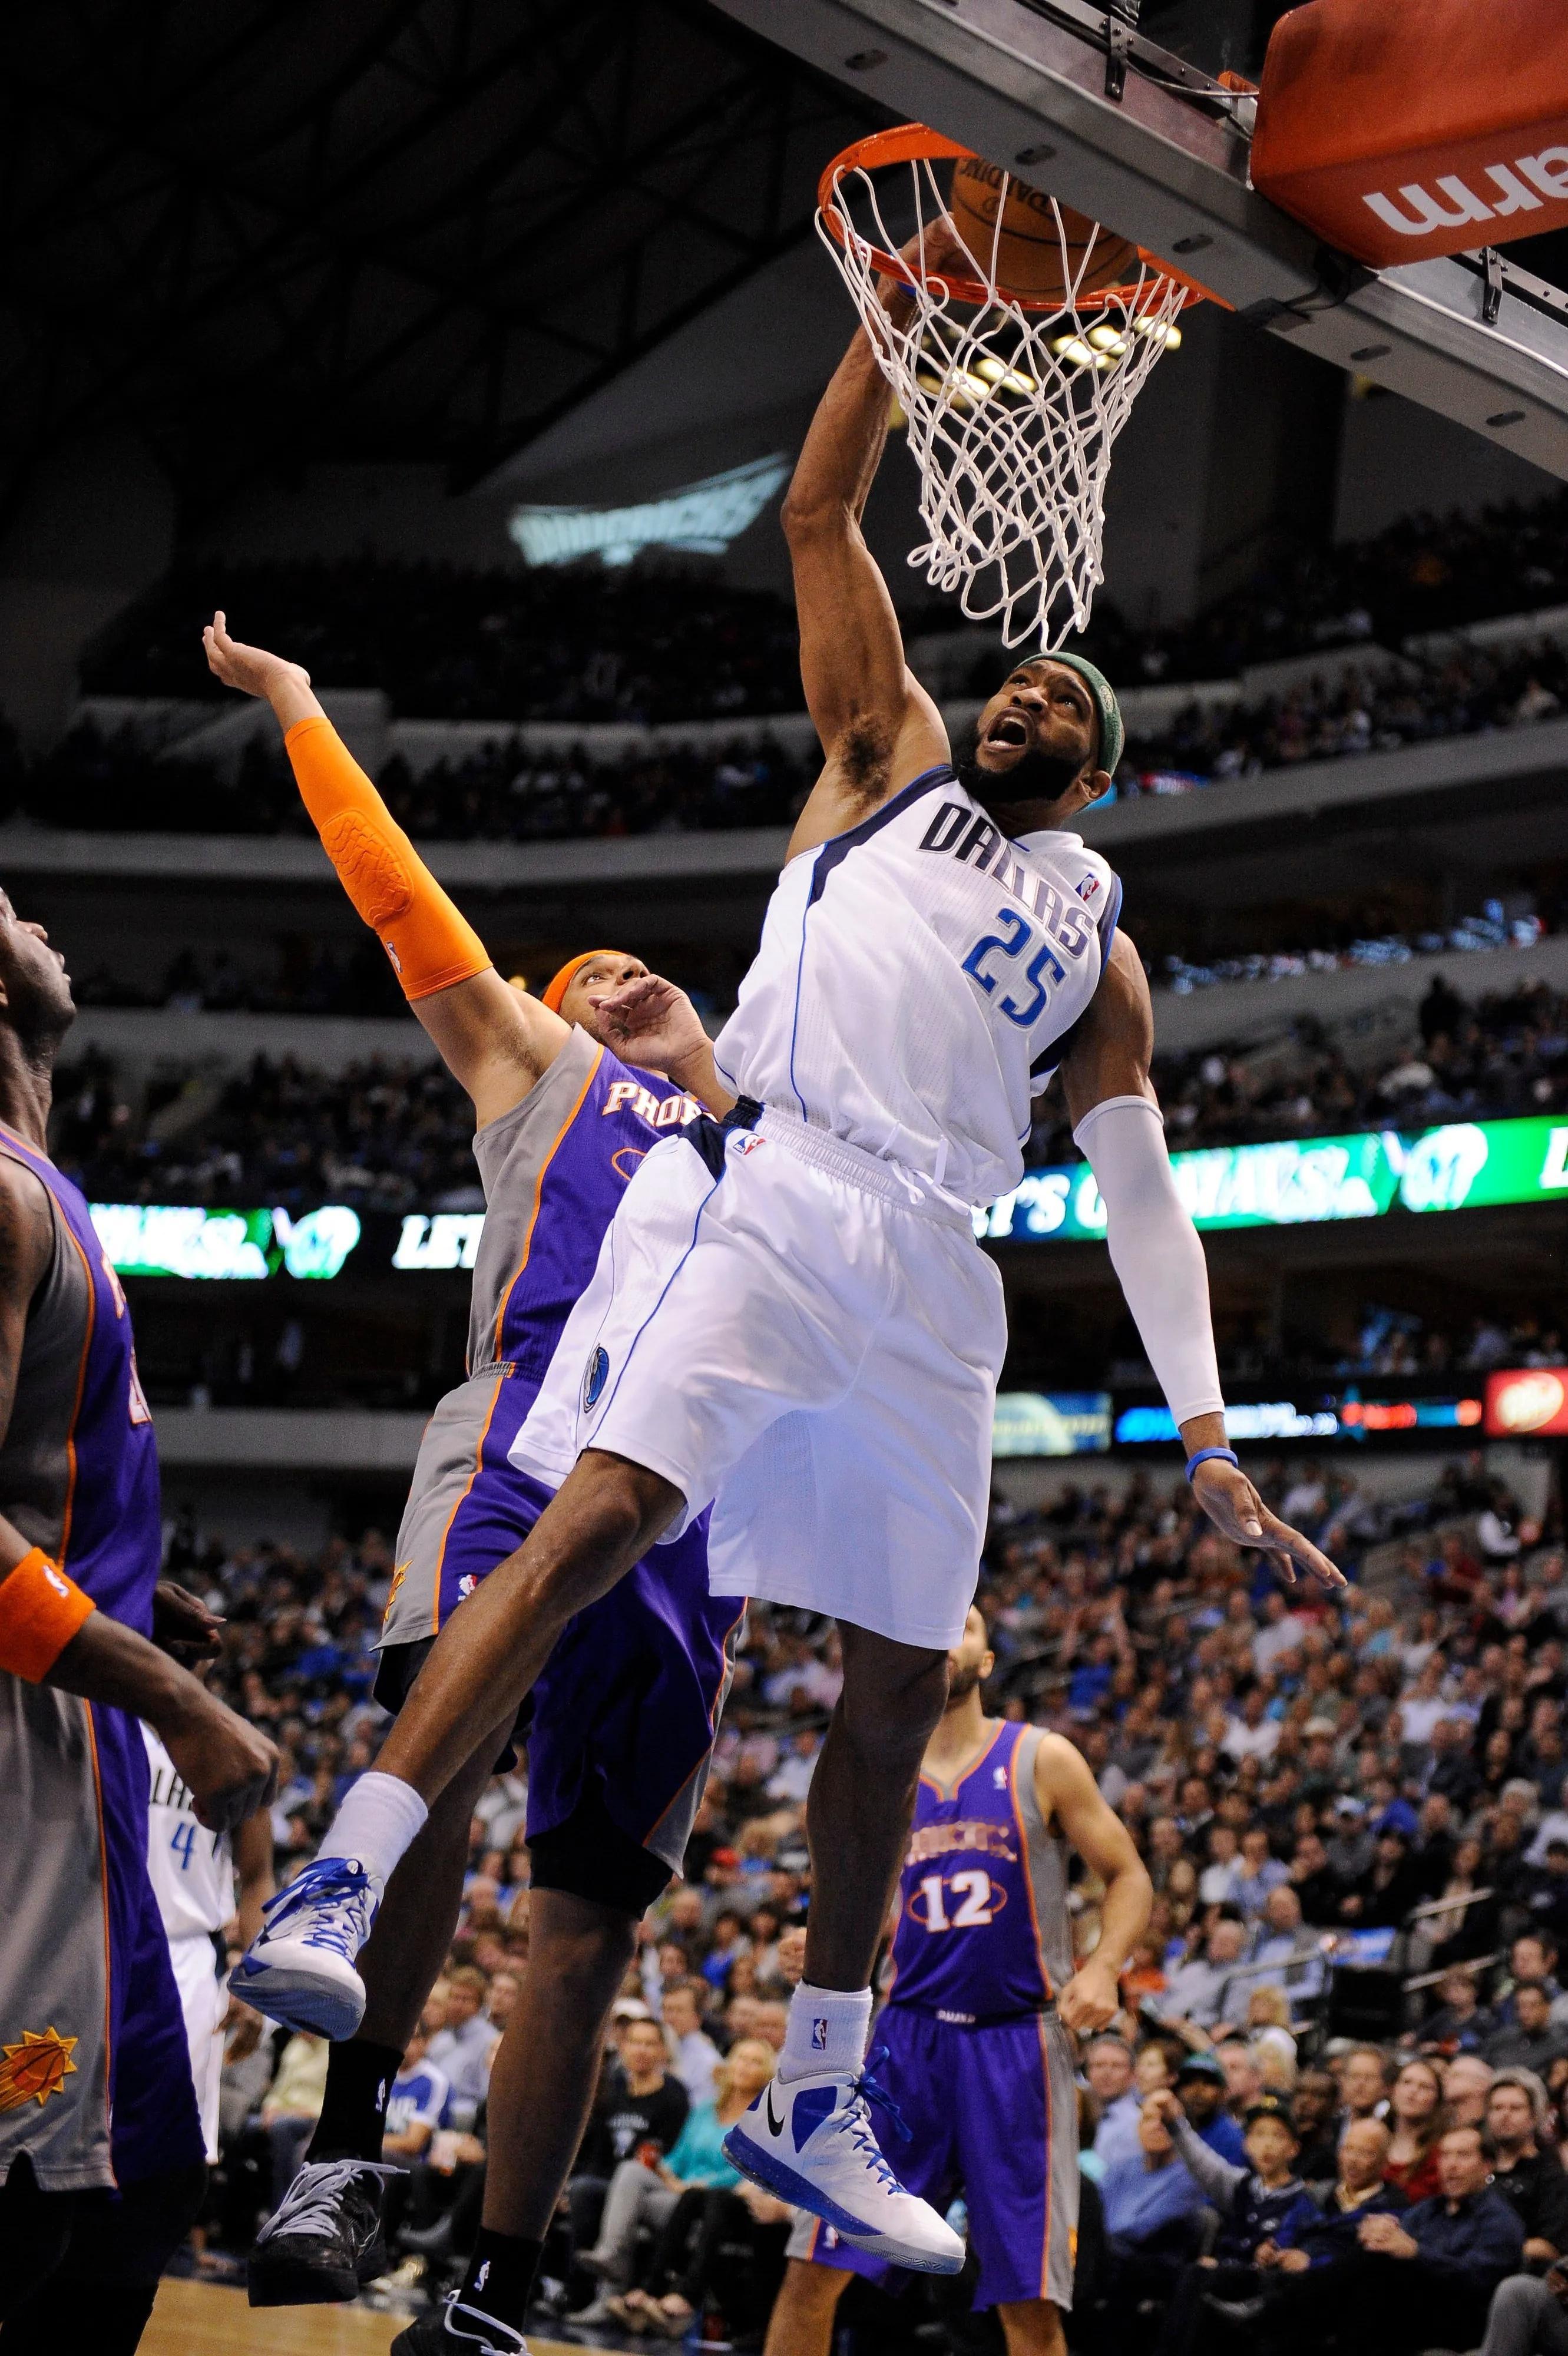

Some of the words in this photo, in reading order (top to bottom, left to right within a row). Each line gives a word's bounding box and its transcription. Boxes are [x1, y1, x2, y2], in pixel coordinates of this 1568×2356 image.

[916, 800, 1097, 960] DALLAS
[961, 906, 1067, 1029] 25
[171, 1821, 196, 1870] 4
[920, 1869, 994, 1934] 12
